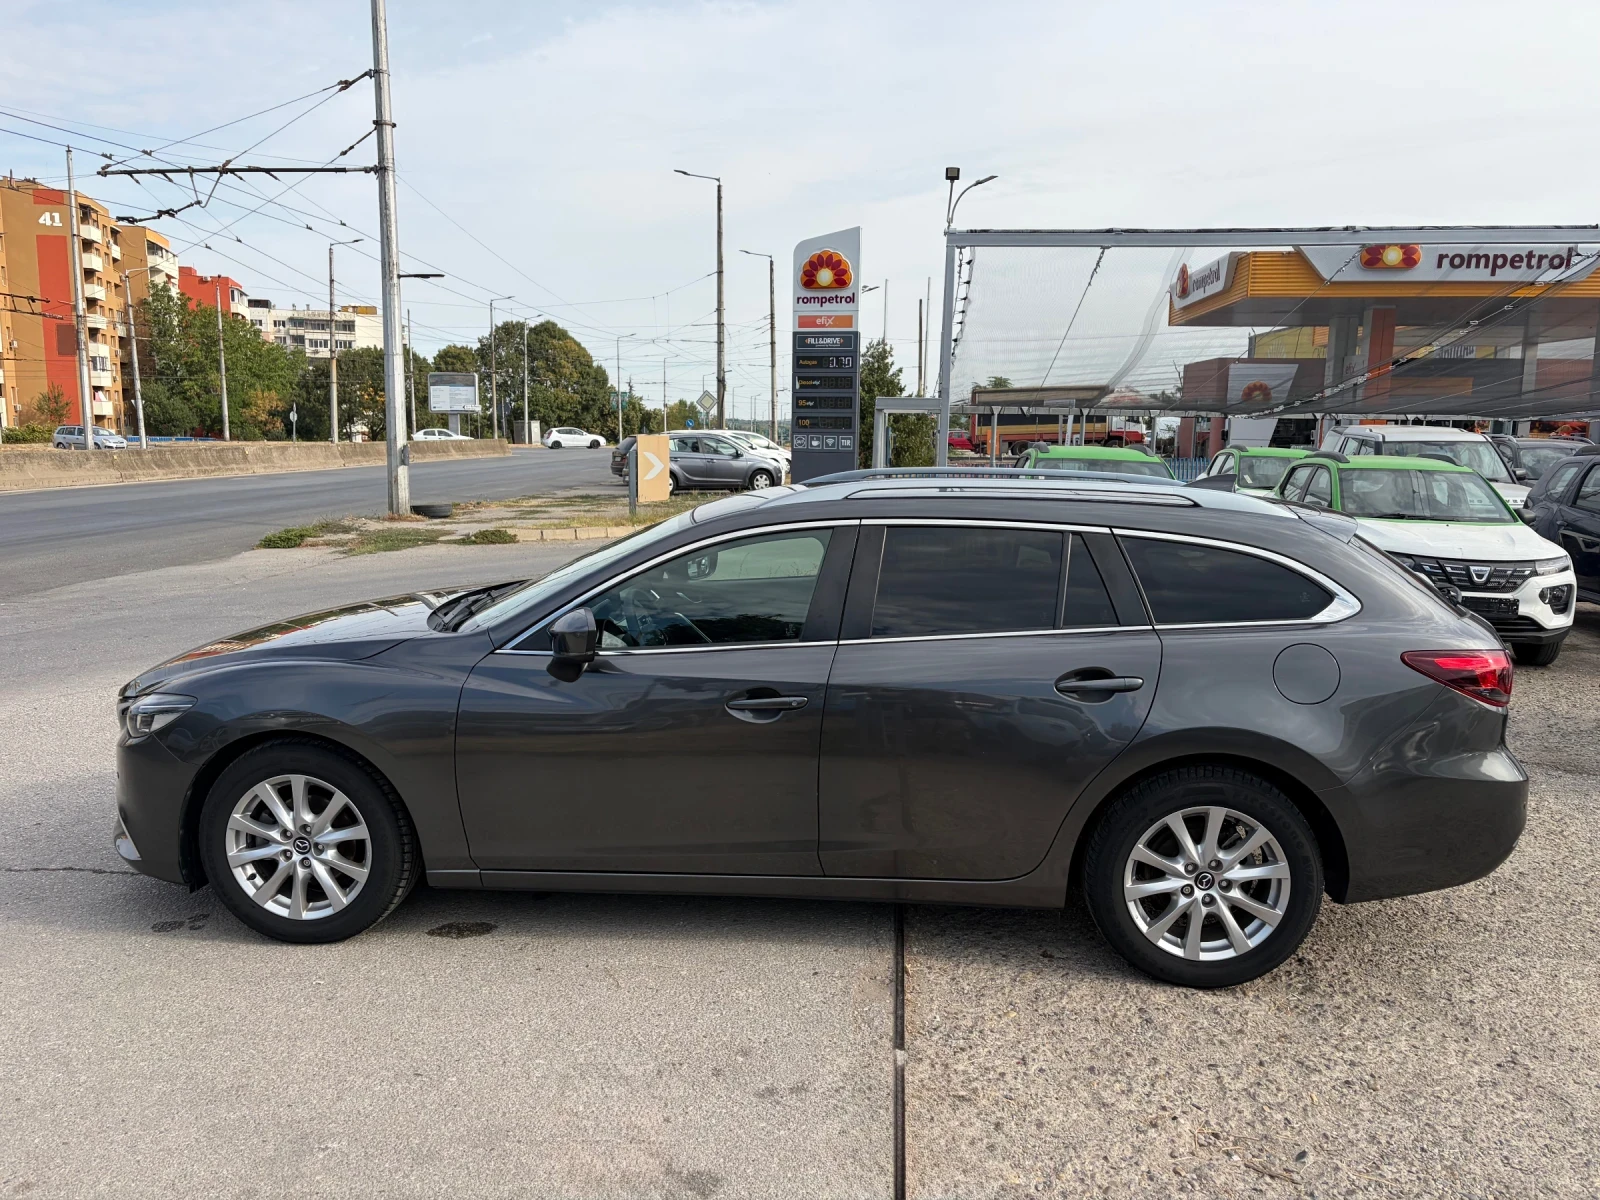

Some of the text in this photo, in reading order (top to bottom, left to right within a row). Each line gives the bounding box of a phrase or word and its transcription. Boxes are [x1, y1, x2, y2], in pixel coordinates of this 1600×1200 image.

[38, 211, 63, 227] 41
[1436, 246, 1574, 277] rompetrol
[797, 292, 855, 307] rompetrol
[816, 316, 835, 326] efix
[841, 439, 851, 447] TIR
